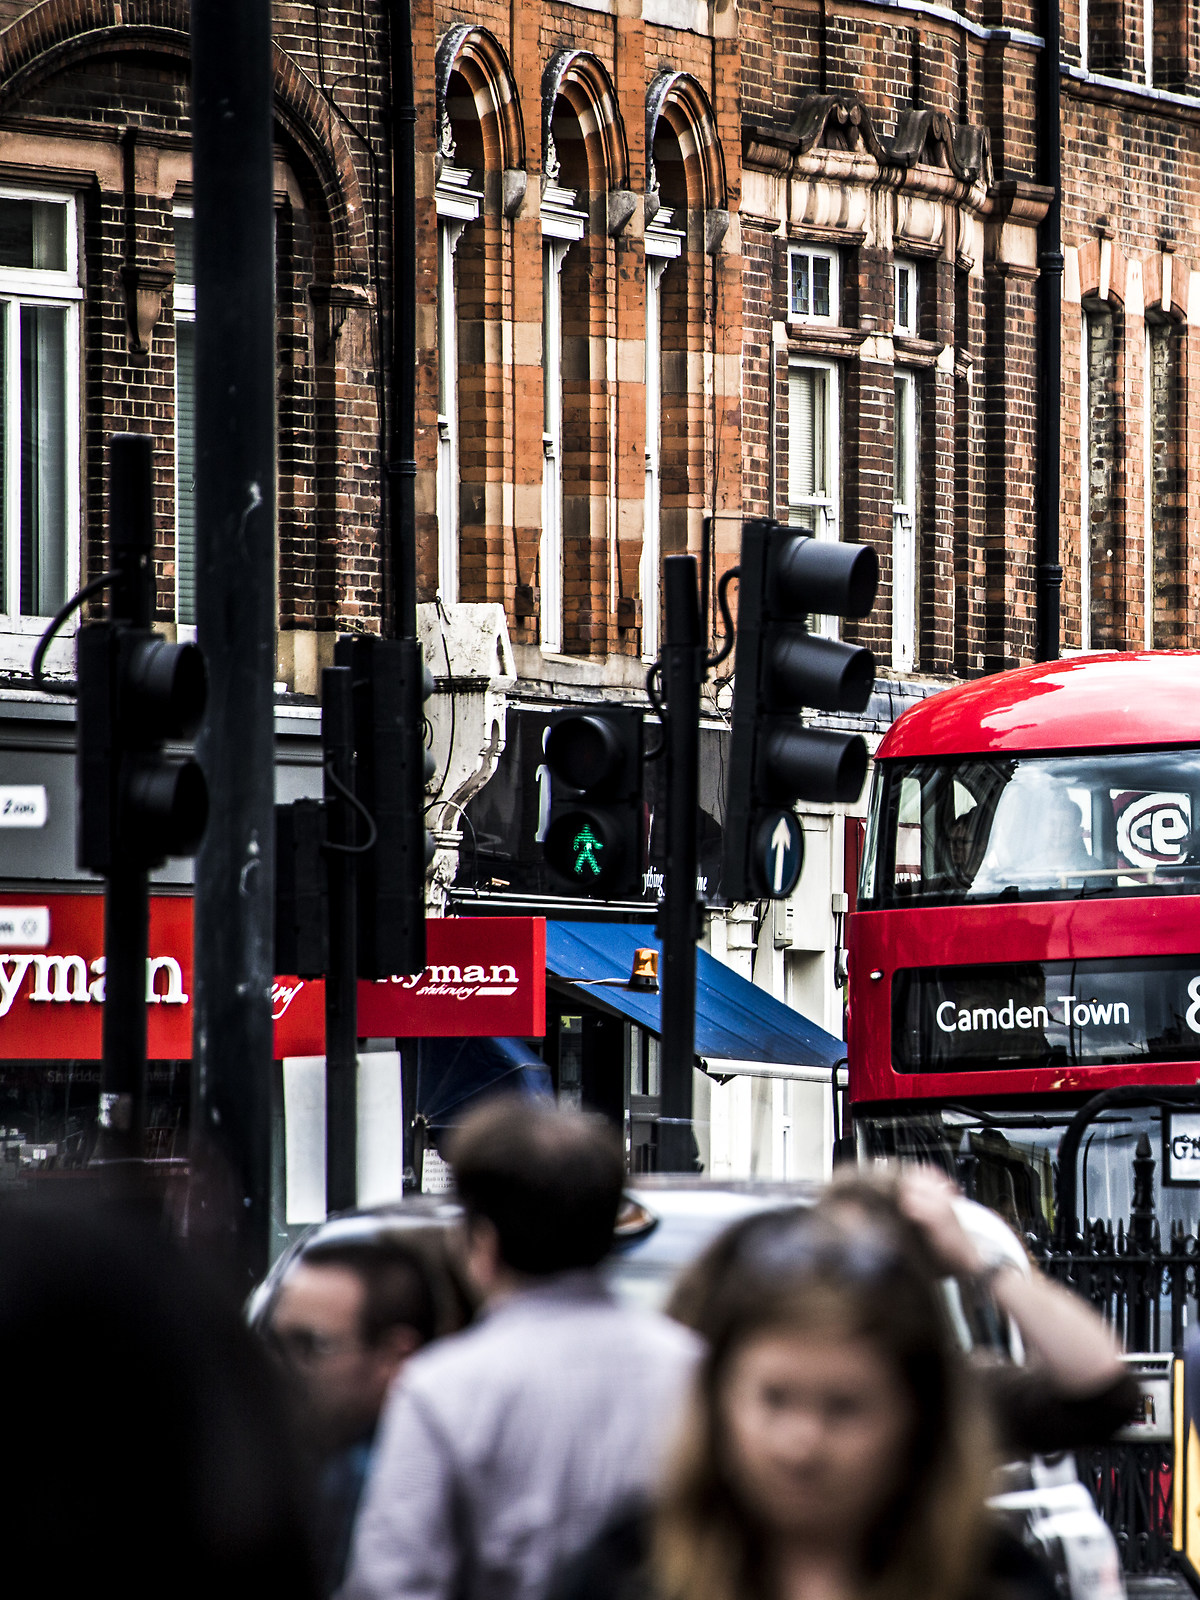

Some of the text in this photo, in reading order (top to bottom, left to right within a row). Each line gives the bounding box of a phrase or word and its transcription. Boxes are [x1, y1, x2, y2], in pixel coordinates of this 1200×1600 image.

[416, 983, 481, 1000] stationery
[936, 998, 1049, 1032] Camden
[1057, 996, 1130, 1026] Town
